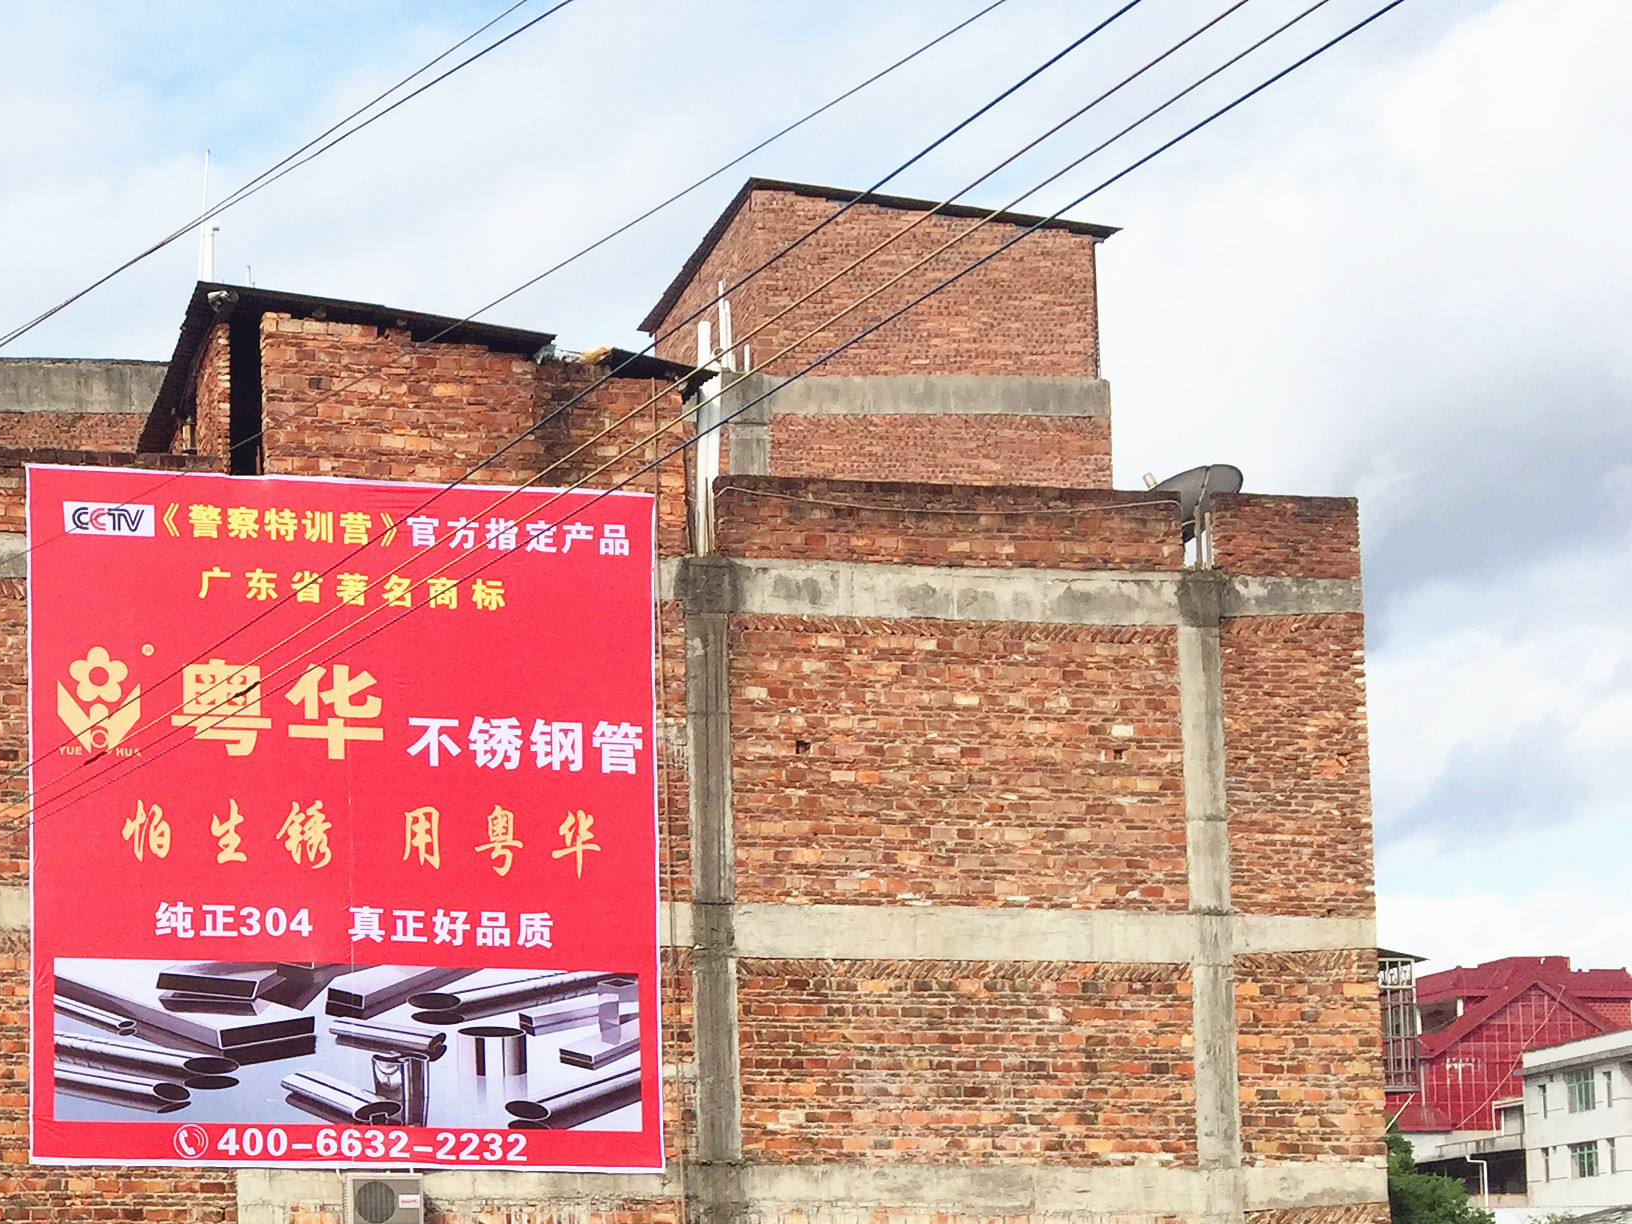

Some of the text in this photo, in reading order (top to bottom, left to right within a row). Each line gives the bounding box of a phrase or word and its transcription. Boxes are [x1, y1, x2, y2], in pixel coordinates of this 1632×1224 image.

[72, 506, 145, 533] CCTV
[198, 565, 506, 611] 广东省著名商标
[171, 657, 384, 760] 粤华
[59, 745, 83, 756] YUE
[406, 716, 644, 775] 不锈钢管
[154, 901, 555, 949] 纯正304 真正好品质
[216, 1127, 529, 1163] 400-6632-2232
